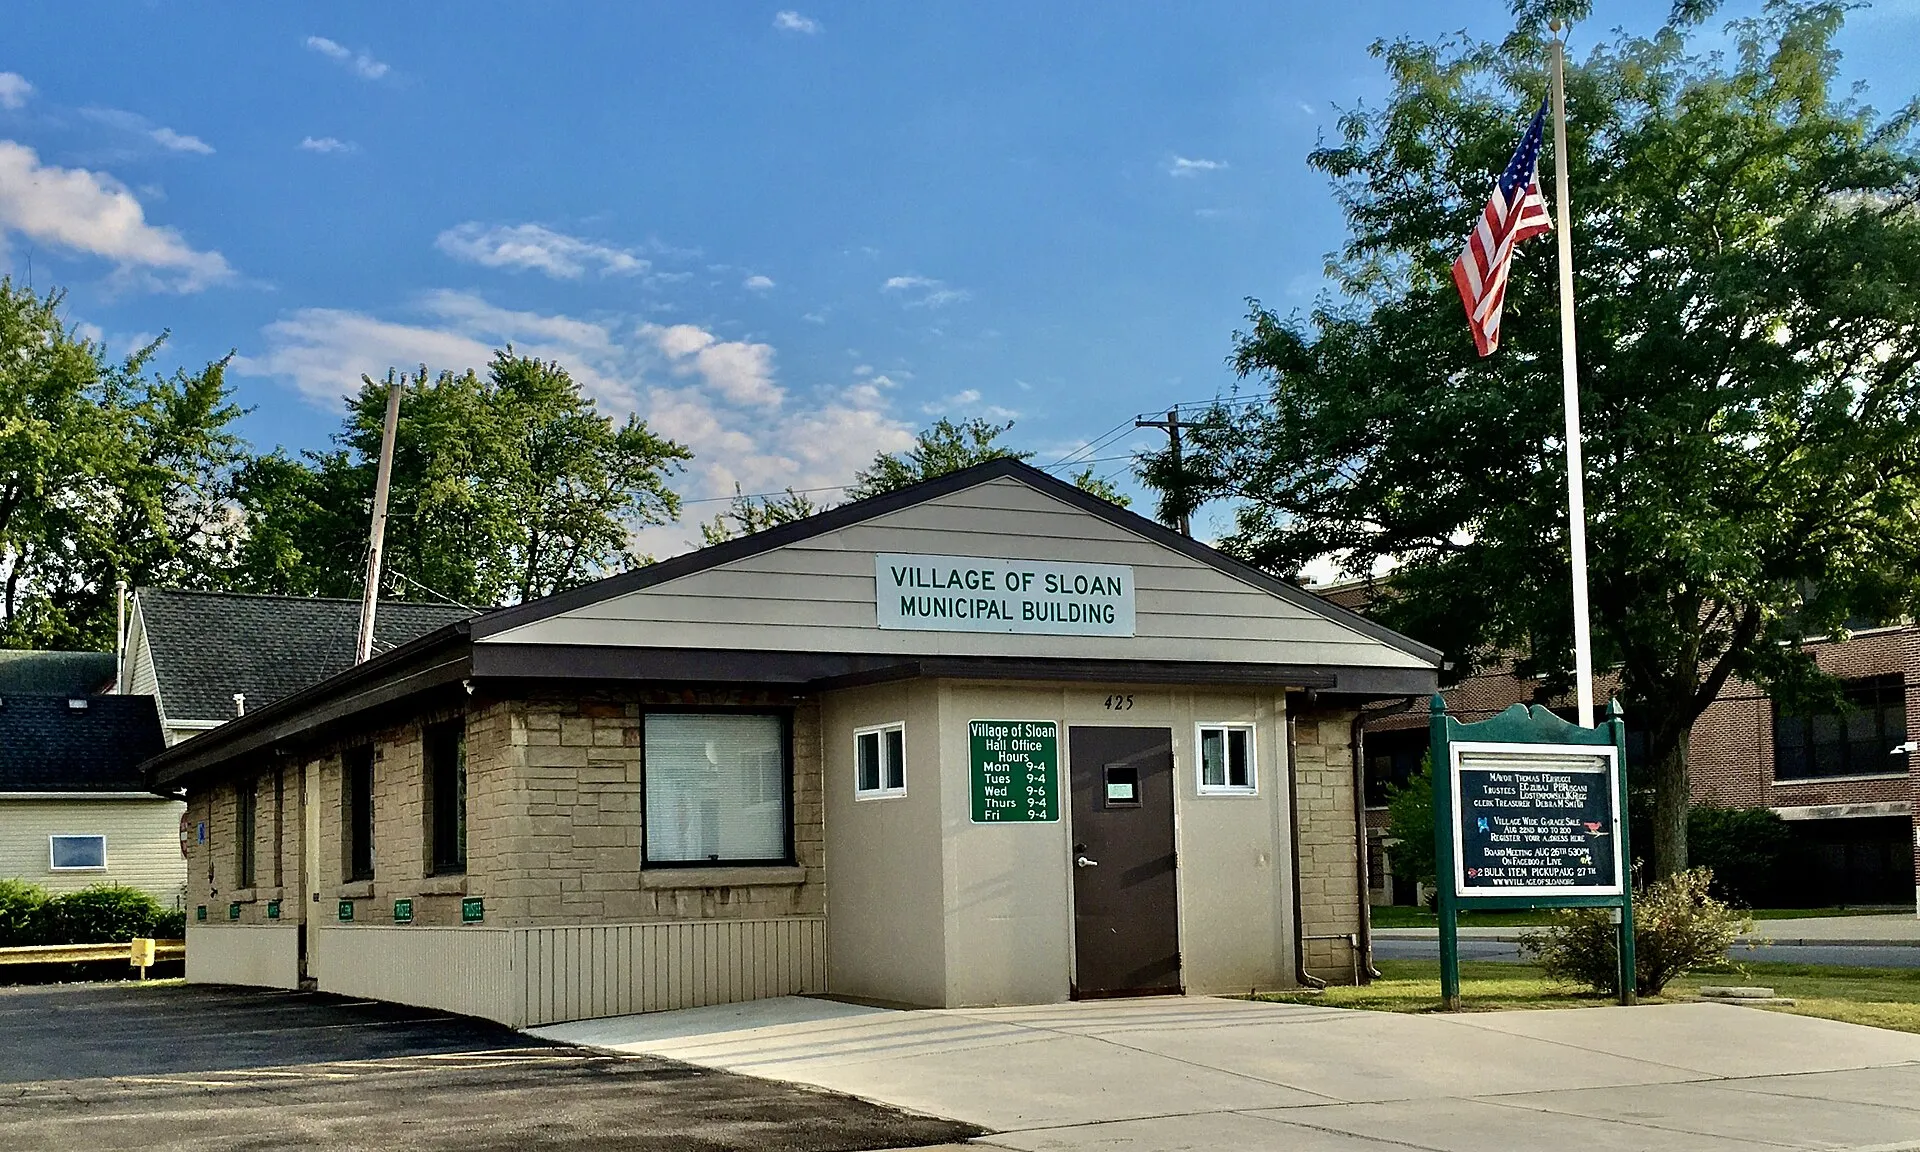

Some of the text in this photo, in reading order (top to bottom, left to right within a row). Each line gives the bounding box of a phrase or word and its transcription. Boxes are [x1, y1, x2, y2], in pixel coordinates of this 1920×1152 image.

[890, 566, 1122, 596] VILLAGE OF SLOAN
[900, 596, 1115, 624] MUNICIPAL BUILDING
[1104, 694, 1134, 710] 425
[971, 723, 1055, 741] Village of Sloan
[986, 739, 1042, 751] Hall Office
[998, 751, 1030, 763] Hours
[983, 761, 1046, 772] Mon 9-4
[984, 774, 1046, 784] Tues 9-4
[1514, 773, 1540, 783] THOMAS
[984, 786, 1046, 797] Wed 9-6
[1482, 785, 1516, 795] TRUSTEES
[984, 797, 1047, 808] Thurs 9-4
[1494, 797, 1531, 808] TREASURER
[984, 809, 1047, 820] Fri 9-4
[1493, 816, 1581, 827] VILLAGE WIDE GARAGE SALE
[1503, 825, 1518, 834] AUG
[1518, 826, 1535, 834] 22ND
[1550, 826, 1559, 834] TO
[1559, 826, 1572, 834] 200
[1490, 832, 1586, 843] REGISTER YOUR ADDRESS HERE
[1483, 847, 1506, 857] BOARD
[1505, 847, 1533, 857] MEETING
[1534, 847, 1550, 857] AUG
[1501, 856, 1513, 866] ON
[1546, 856, 1562, 866] LIVE
[1484, 867, 1505, 877] BULK
[1508, 867, 1528, 877] ITEM
[1531, 867, 1559, 877] PICKUP
[1558, 867, 1575, 877] AUG
